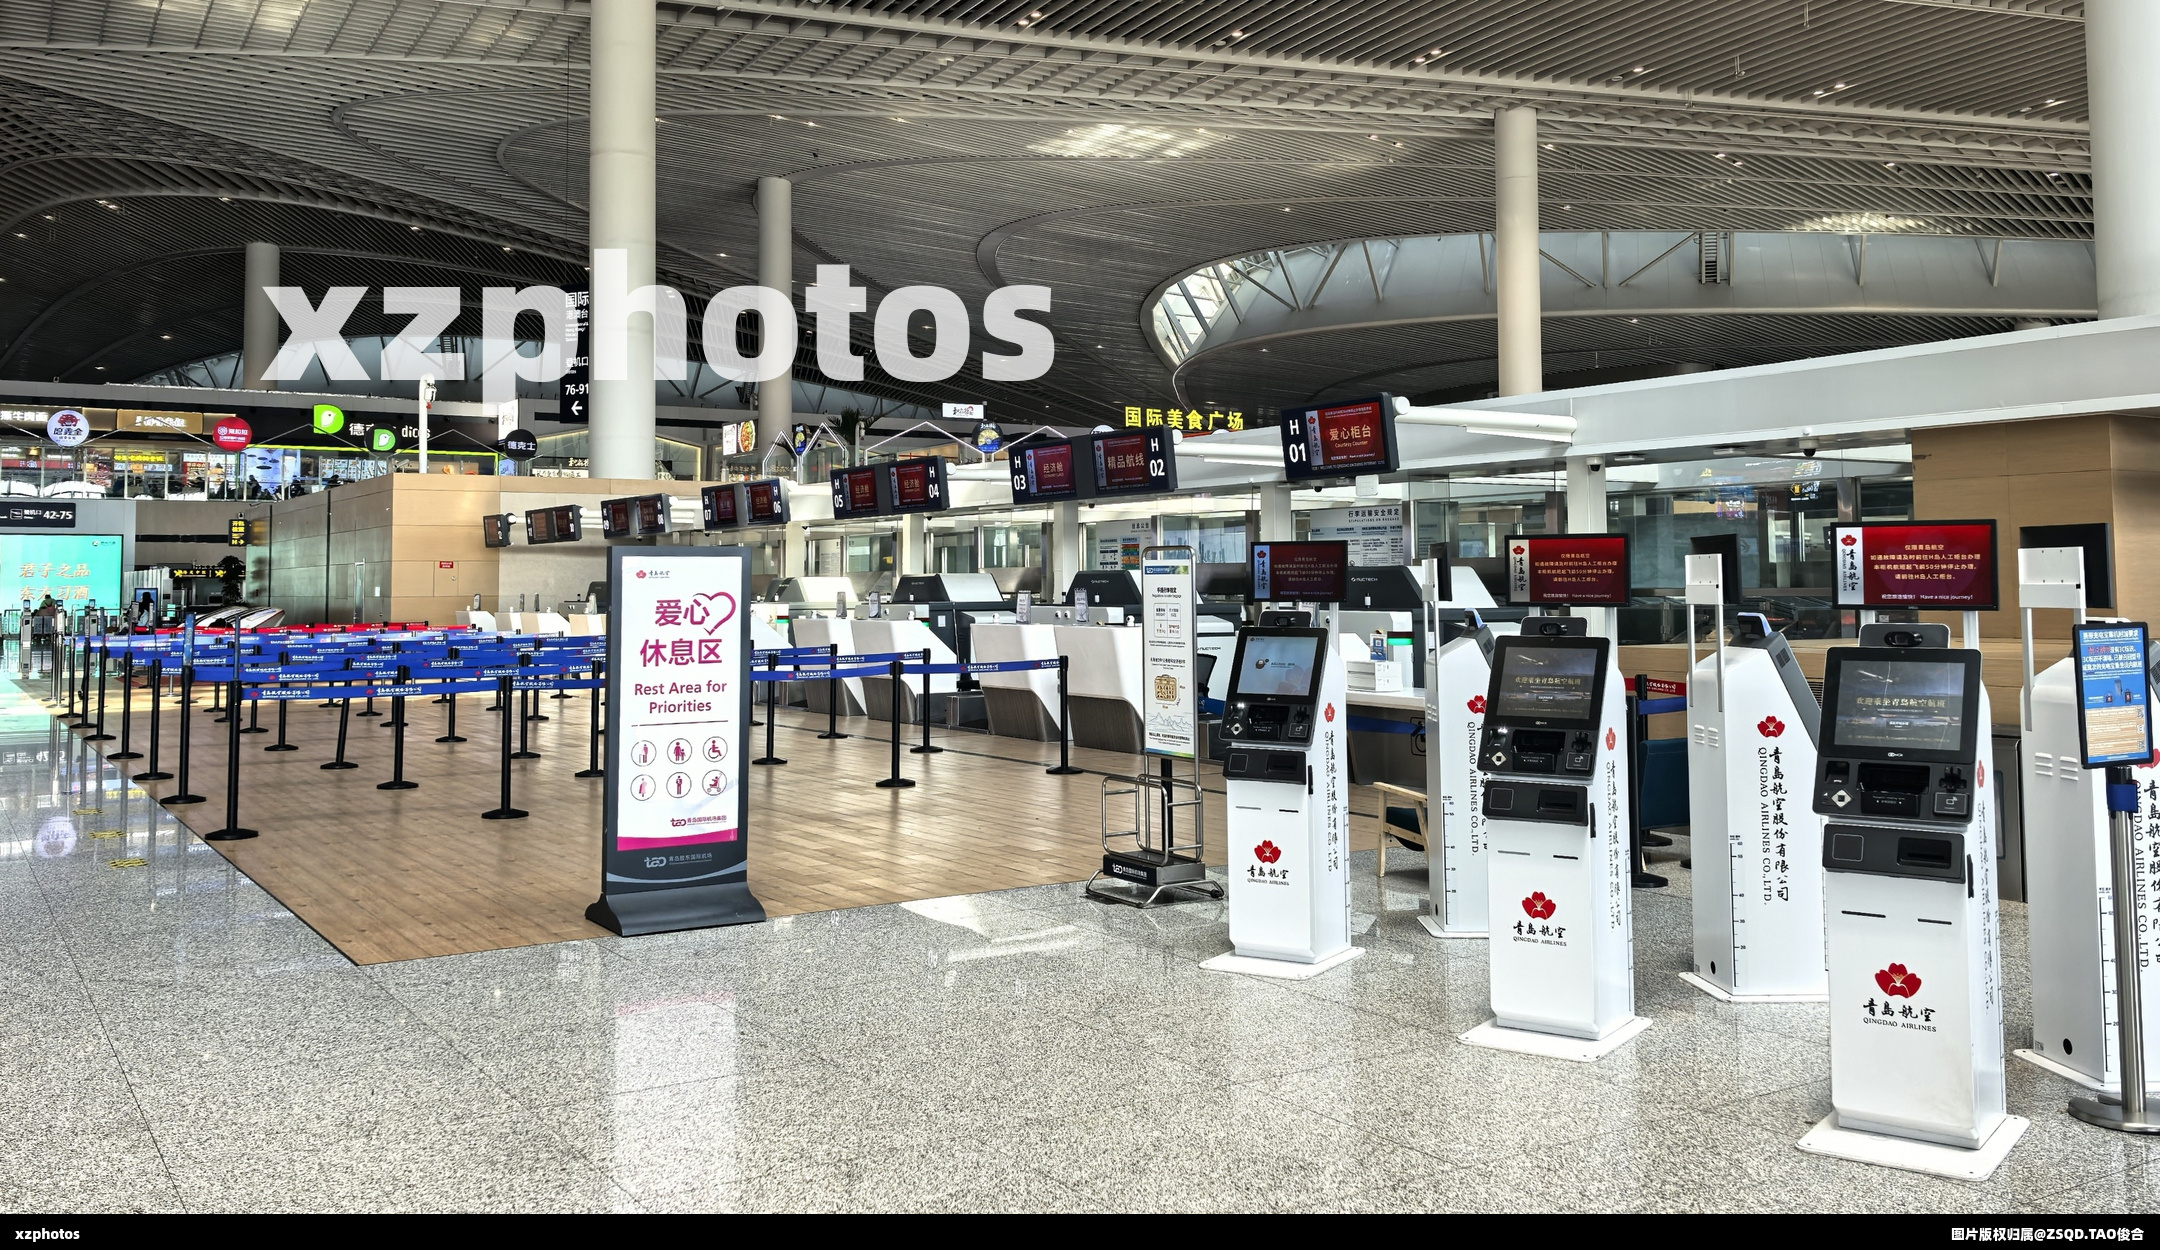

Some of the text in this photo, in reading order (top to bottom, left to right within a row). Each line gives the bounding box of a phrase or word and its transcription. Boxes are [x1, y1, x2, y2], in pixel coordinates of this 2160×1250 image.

[565, 383, 589, 395] 76-91
[1124, 406, 1244, 431] 国际美食广场
[1289, 419, 1300, 435] H
[1329, 424, 1371, 441] 爱心柜台
[508, 441, 536, 451] 德克士
[1151, 438, 1159, 452] H
[1289, 443, 1306, 463] 01
[1014, 456, 1021, 468] H
[1043, 461, 1064, 474] 经济舱
[1107, 453, 1145, 470] 精品航线
[1150, 459, 1165, 477] 02
[928, 466, 935, 478] H
[834, 479, 840, 489] H
[1013, 474, 1027, 490] 03
[773, 486, 778, 496] H
[928, 484, 939, 498] 04
[704, 496, 708, 504] H
[773, 501, 781, 513] 06
[834, 495, 843, 508] 05
[43, 510, 73, 520] 42-75
[704, 509, 711, 520] 07
[1348, 508, 1399, 518] 行李运输安全规定
[19, 563, 90, 578] 君子之品
[20, 586, 89, 600] 东方习酒
[655, 599, 711, 627] 爱心
[640, 638, 723, 667] 休息区
[634, 680, 727, 696] Rest Area for
[649, 699, 711, 716] Priorities
[1856, 696, 1946, 708] 欢迎乘坐青岛航空航班
[1467, 722, 1476, 764] QINGDAO
[1758, 747, 1768, 797] QINGDAO
[1470, 768, 1478, 812] AIRLINES
[1761, 802, 1770, 853] AIRLINES
[669, 852, 712, 862] 青岛胶东国际机场
[2135, 848, 2146, 909] AIRLINES
[1540, 937, 1567, 947] AIRLINES
[1863, 1017, 1937, 1032] QINGDAO AIRLINES
